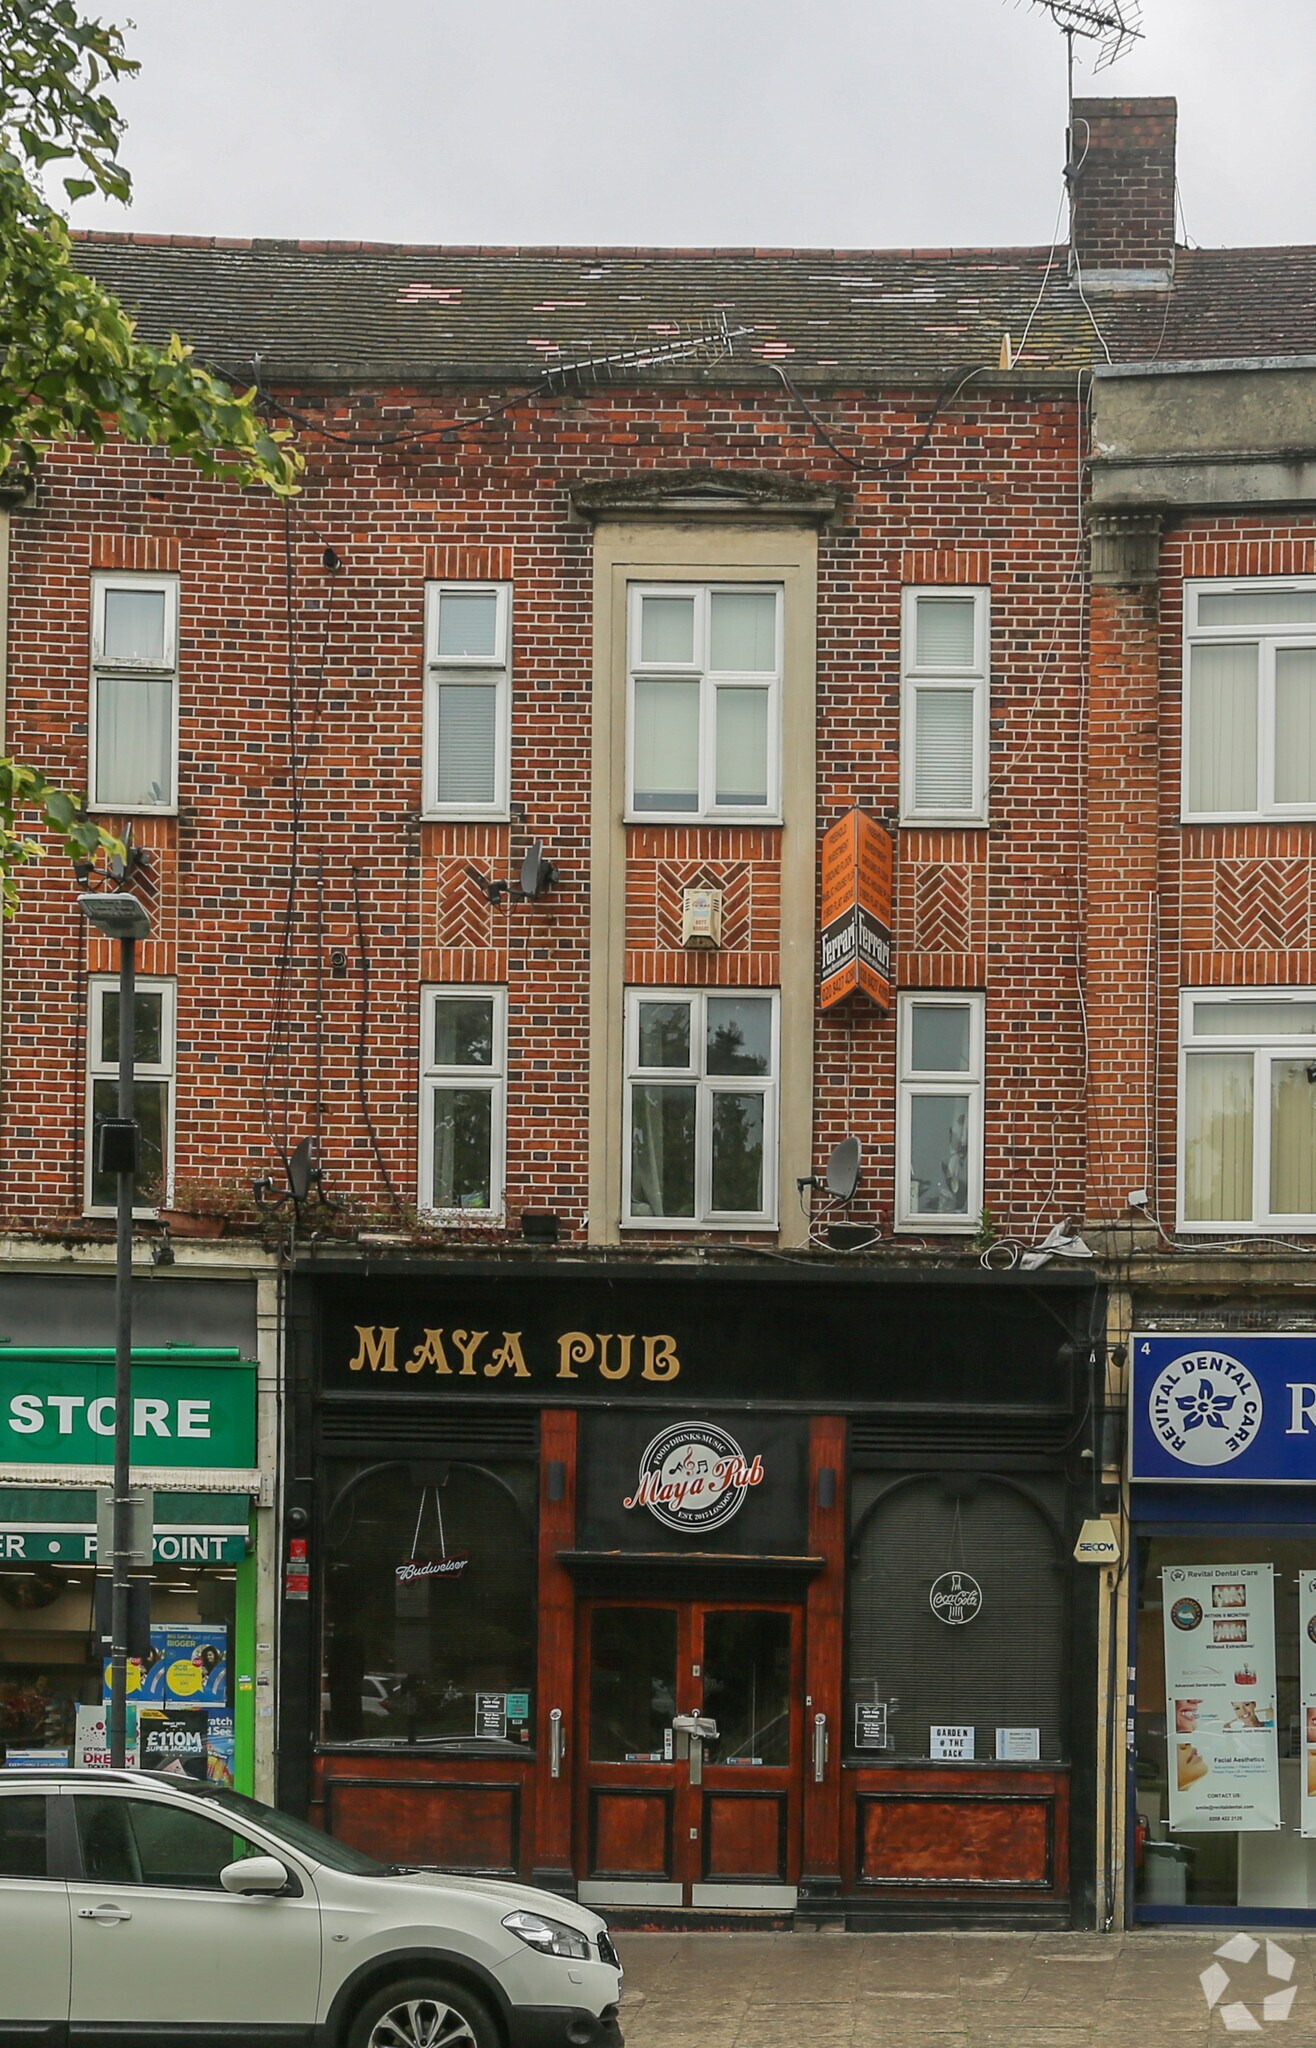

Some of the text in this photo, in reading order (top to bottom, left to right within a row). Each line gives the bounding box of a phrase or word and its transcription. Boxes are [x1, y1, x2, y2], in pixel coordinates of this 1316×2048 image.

[822, 916, 856, 970] Ferrari
[858, 911, 891, 970] Ferrari
[349, 1325, 681, 1382] MAYA PUB
[1140, 1342, 1151, 1356] 4
[1155, 1356, 1258, 1452] REVITAL DENTAL CARE
[8, 1394, 211, 1438] STORE
[623, 1454, 765, 1512] Maya Pub
[1079, 1543, 1114, 1552] SECOM
[395, 1560, 468, 1580] Budweiser
[1187, 1570, 1214, 1578] Revital
[1215, 1569, 1239, 1577] Dental
[212, 1726, 232, 1736] See
[936, 1729, 968, 1738] GARDEN
[146, 1731, 203, 1747] £110M
[949, 1739, 964, 1748] THE
[145, 1745, 169, 1753] SUPER
[169, 1745, 203, 1753] JACKPOT
[942, 1750, 963, 1758] BACK
[83, 1752, 135, 1766] DREM
